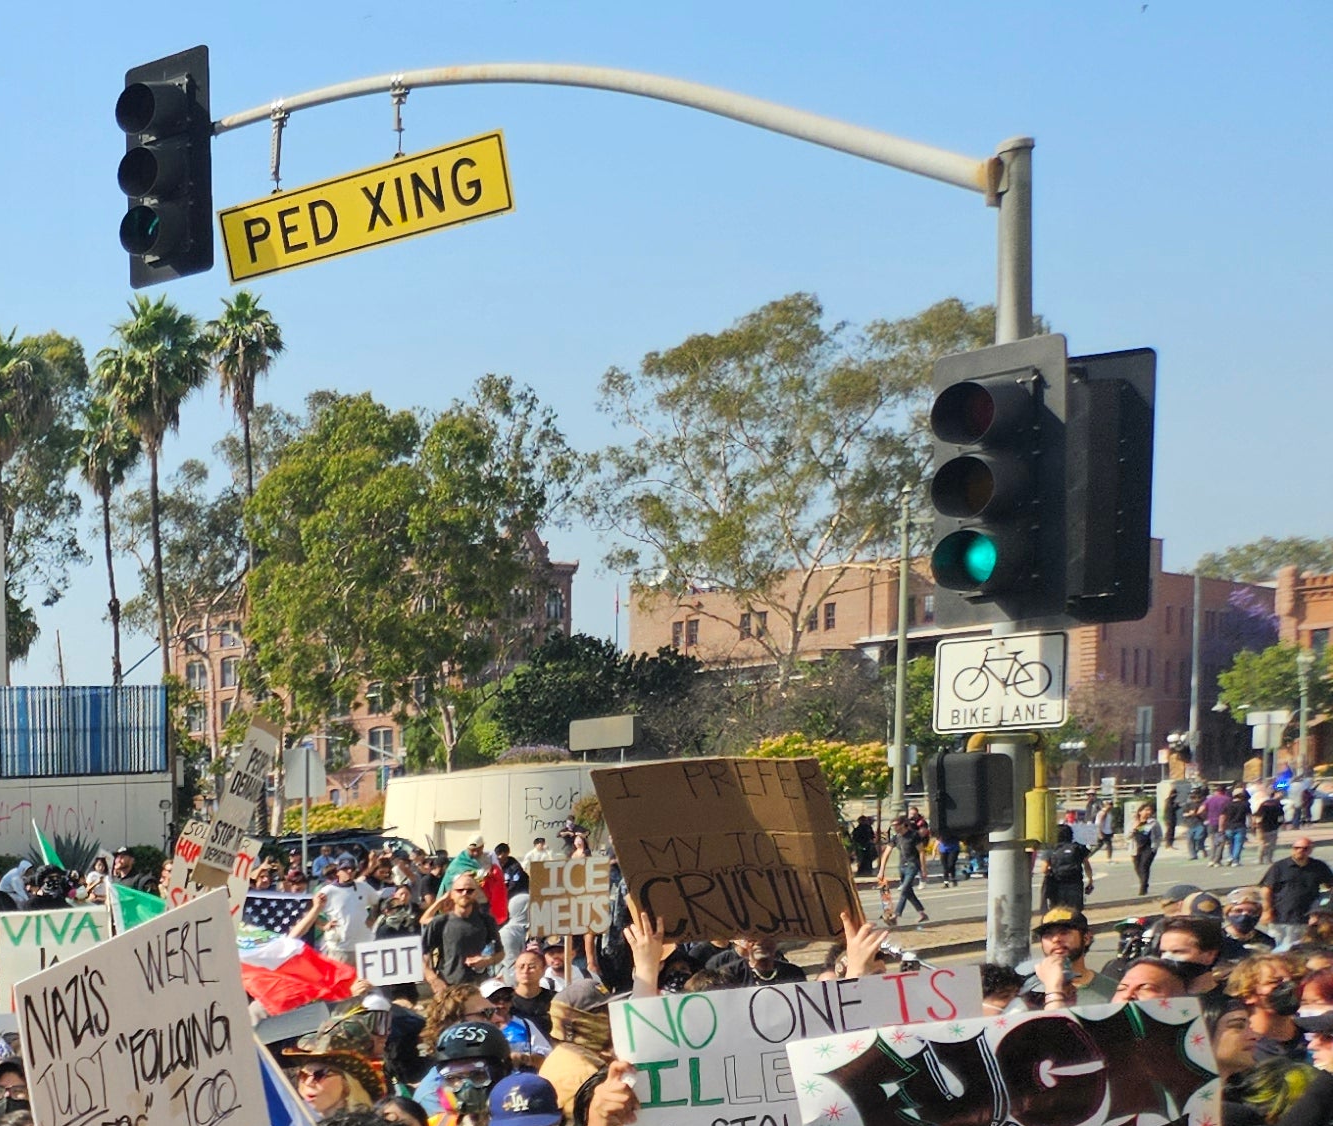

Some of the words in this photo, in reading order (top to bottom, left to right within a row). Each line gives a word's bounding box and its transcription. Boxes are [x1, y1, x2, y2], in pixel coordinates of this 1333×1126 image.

[244, 200, 338, 263] PED
[360, 157, 482, 232] XING
[951, 708, 990, 725] BIKE
[1000, 703, 1047, 723] LANE
[607, 769, 641, 800] I
[683, 759, 825, 800] PREFER
[525, 815, 567, 833] Trum
[640, 836, 702, 868] MY
[725, 832, 793, 866] ICE
[541, 857, 609, 896] ICE
[1, 912, 102, 946] VIVA
[530, 896, 612, 937] MELTS
[134, 917, 219, 994] WERE
[361, 946, 417, 979] FDT
[623, 993, 716, 1052] NO
[749, 978, 870, 1042] ONE
[883, 969, 957, 1026] IS
[635, 1051, 798, 1109] ILLE
